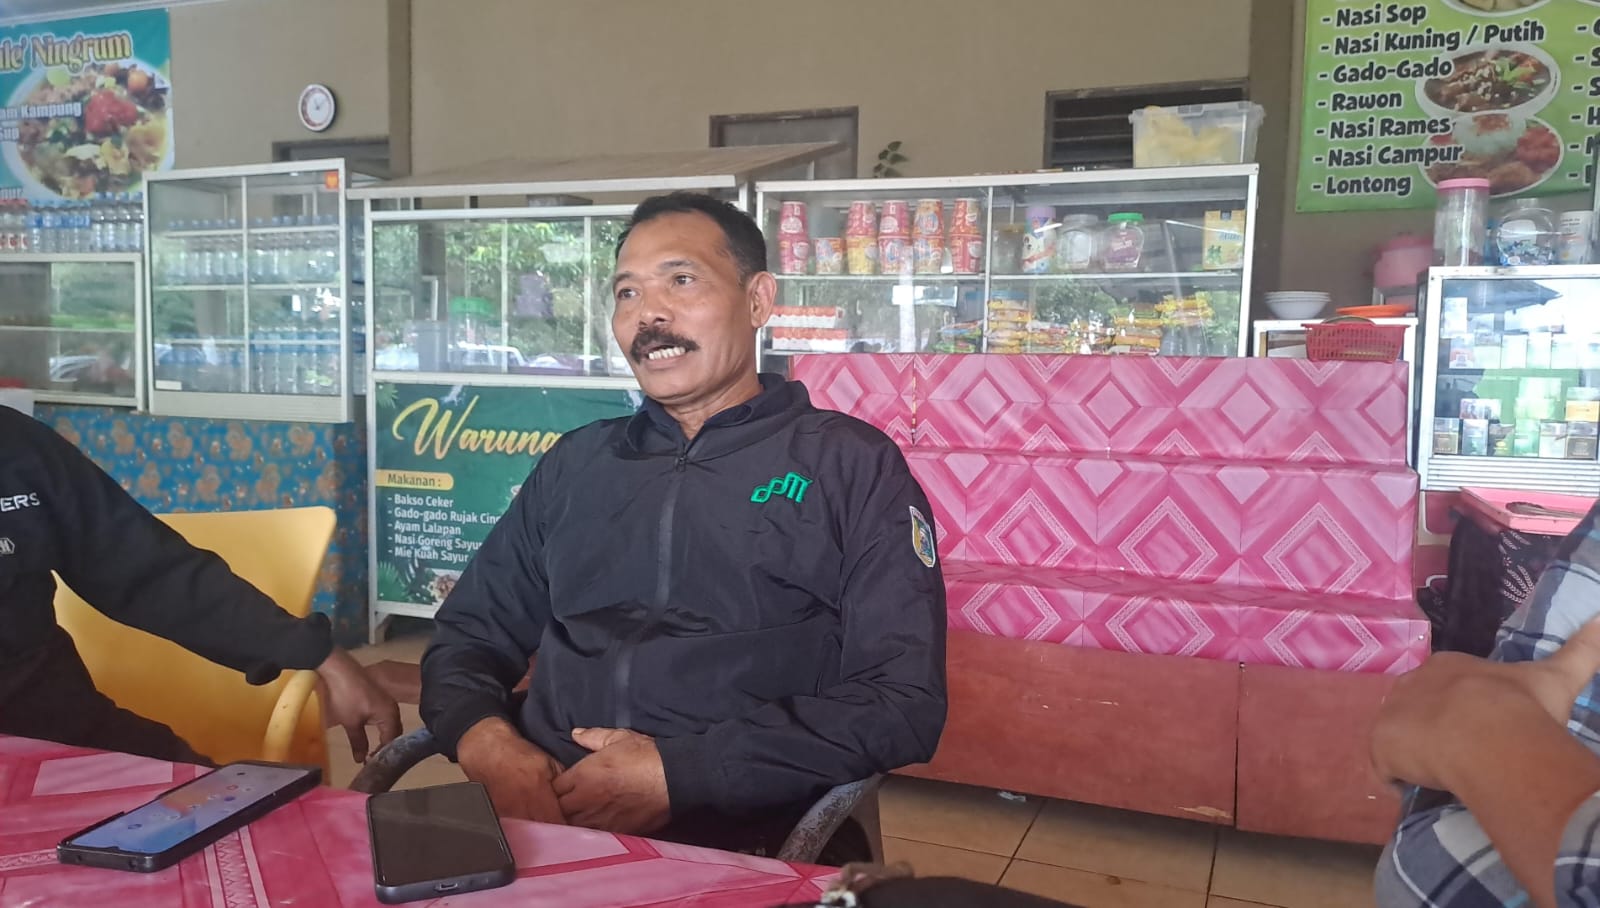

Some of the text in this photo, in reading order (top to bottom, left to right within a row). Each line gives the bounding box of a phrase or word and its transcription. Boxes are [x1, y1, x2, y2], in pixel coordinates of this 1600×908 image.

[1336, 3, 1381, 27] Nasi
[1386, 4, 1427, 25] Sop
[1334, 32, 1379, 55] Nasi
[1385, 28, 1460, 51] Kuning
[1466, 25, 1478, 45] /
[1484, 20, 1544, 43] Putih
[31, 32, 132, 74] Ningrum
[1333, 57, 1452, 83] Gado-Gado
[21, 101, 82, 119] Kampung
[1332, 93, 1402, 111] Rawon
[1330, 117, 1374, 139] Nasi
[1380, 118, 1451, 137] Rames
[1328, 145, 1373, 167] Nasi
[1378, 146, 1462, 167] Campur
[1327, 177, 1411, 196] Lontong
[388, 473, 436, 487] Makanan
[394, 493, 423, 506] Bakso
[425, 496, 454, 508] Ceker
[394, 507, 448, 522] Gado-gado
[450, 511, 478, 524] Rujak
[394, 520, 421, 533] Ayam
[422, 522, 462, 536] Lalapan
[394, 533, 416, 545] Nasi
[417, 535, 453, 550] Goreng
[394, 546, 412, 558] Mie
[414, 547, 439, 560] Kuah
[440, 550, 470, 564] Sayur
